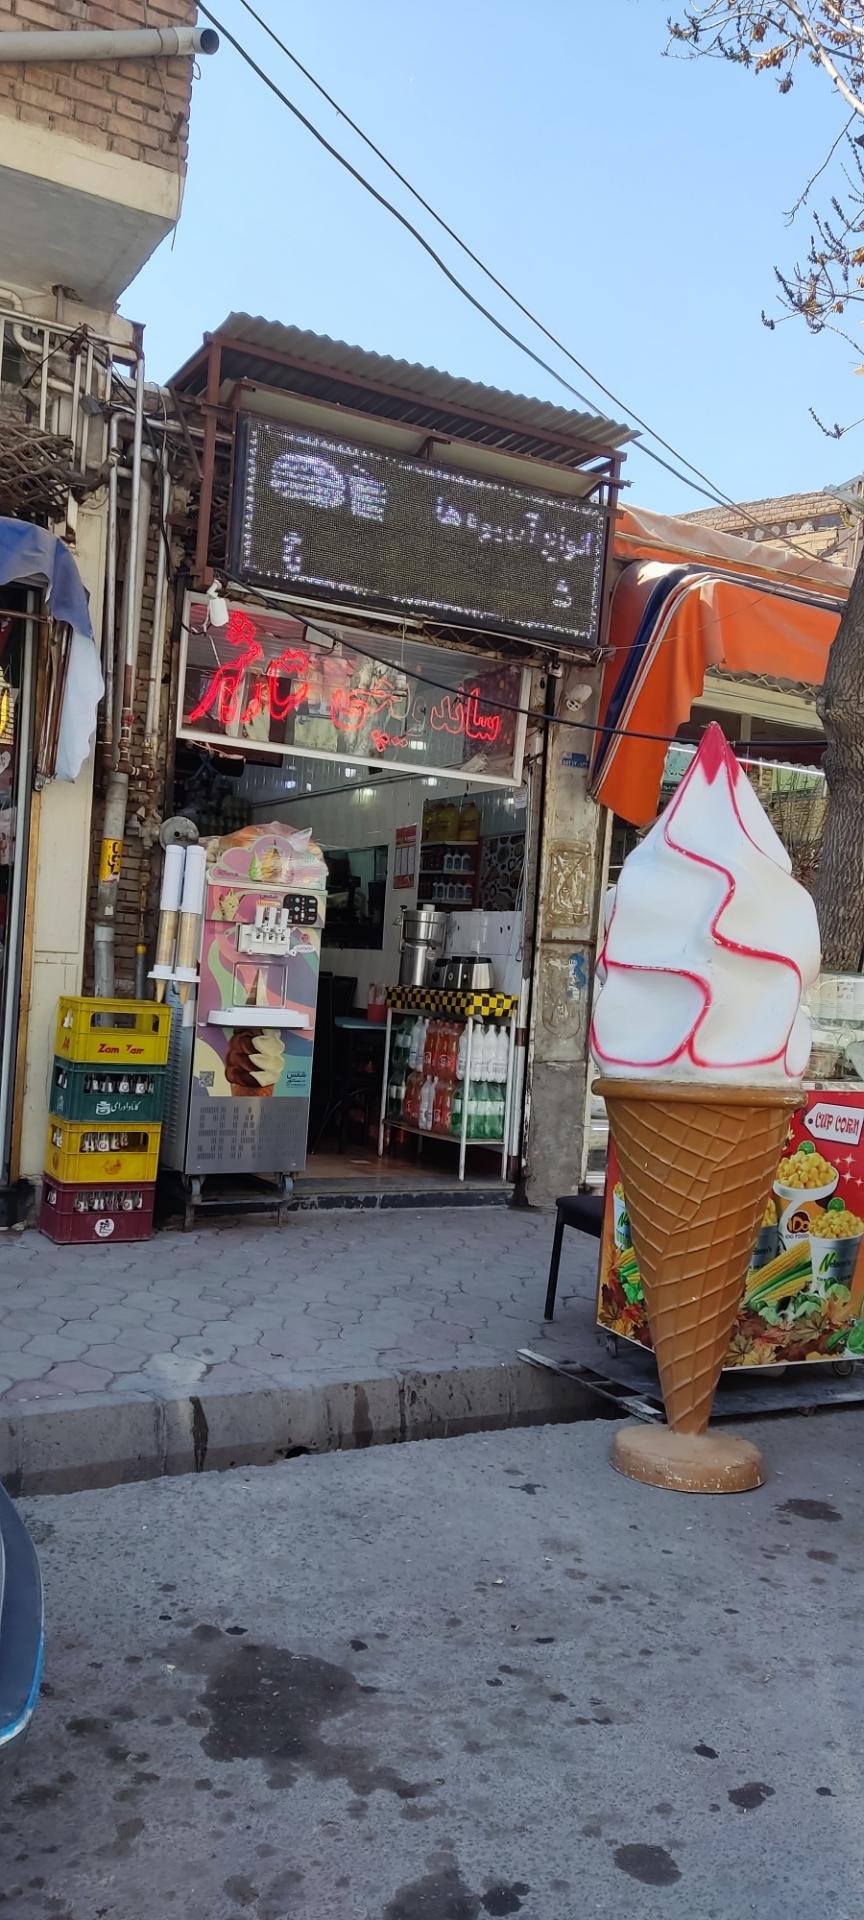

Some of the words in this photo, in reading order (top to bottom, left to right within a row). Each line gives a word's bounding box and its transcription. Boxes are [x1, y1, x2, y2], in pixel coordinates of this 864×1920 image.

[97, 1043, 120, 1054] Zam
[815, 1112, 834, 1130] CUP
[834, 1115, 860, 1136] CORN
